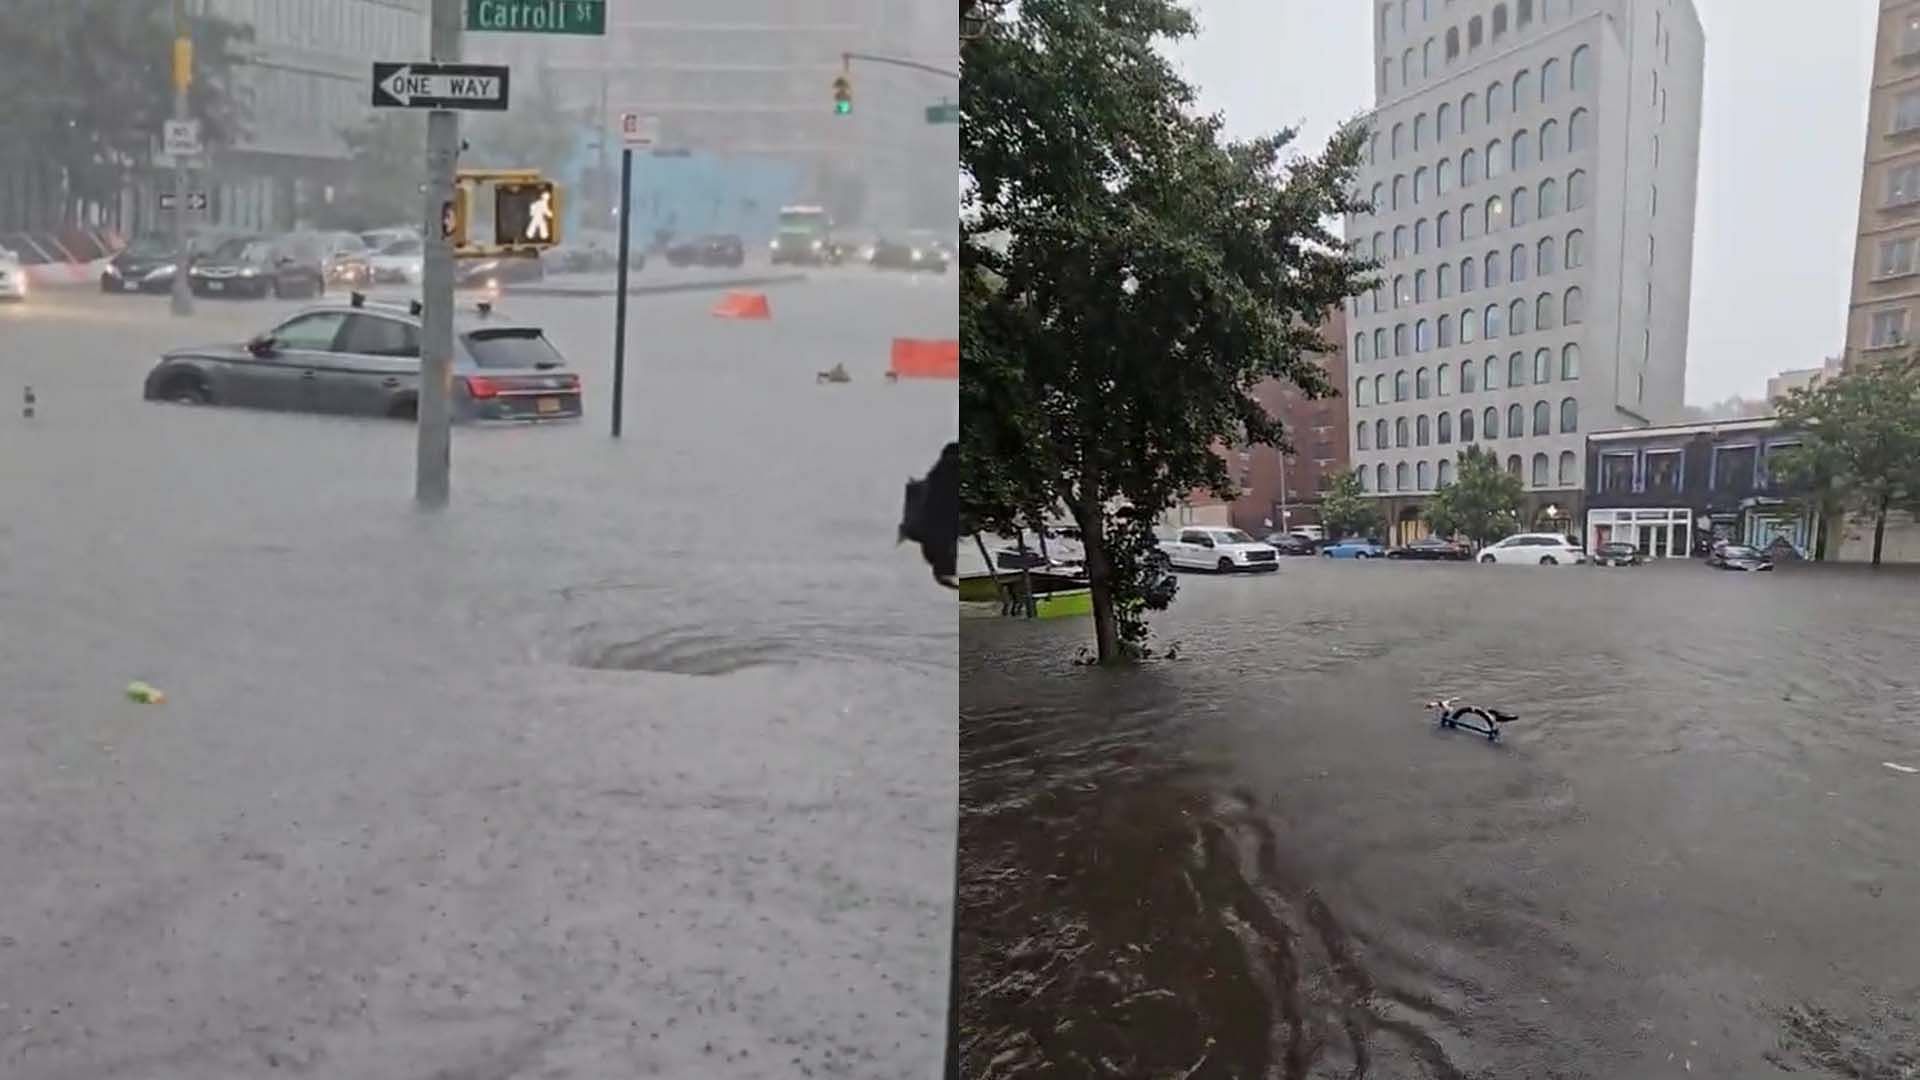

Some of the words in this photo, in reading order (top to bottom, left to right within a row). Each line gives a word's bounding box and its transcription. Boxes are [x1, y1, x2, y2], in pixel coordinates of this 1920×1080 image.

[479, 0, 566, 28] Carroll
[393, 76, 431, 95] ONE
[450, 78, 491, 97] WAY
